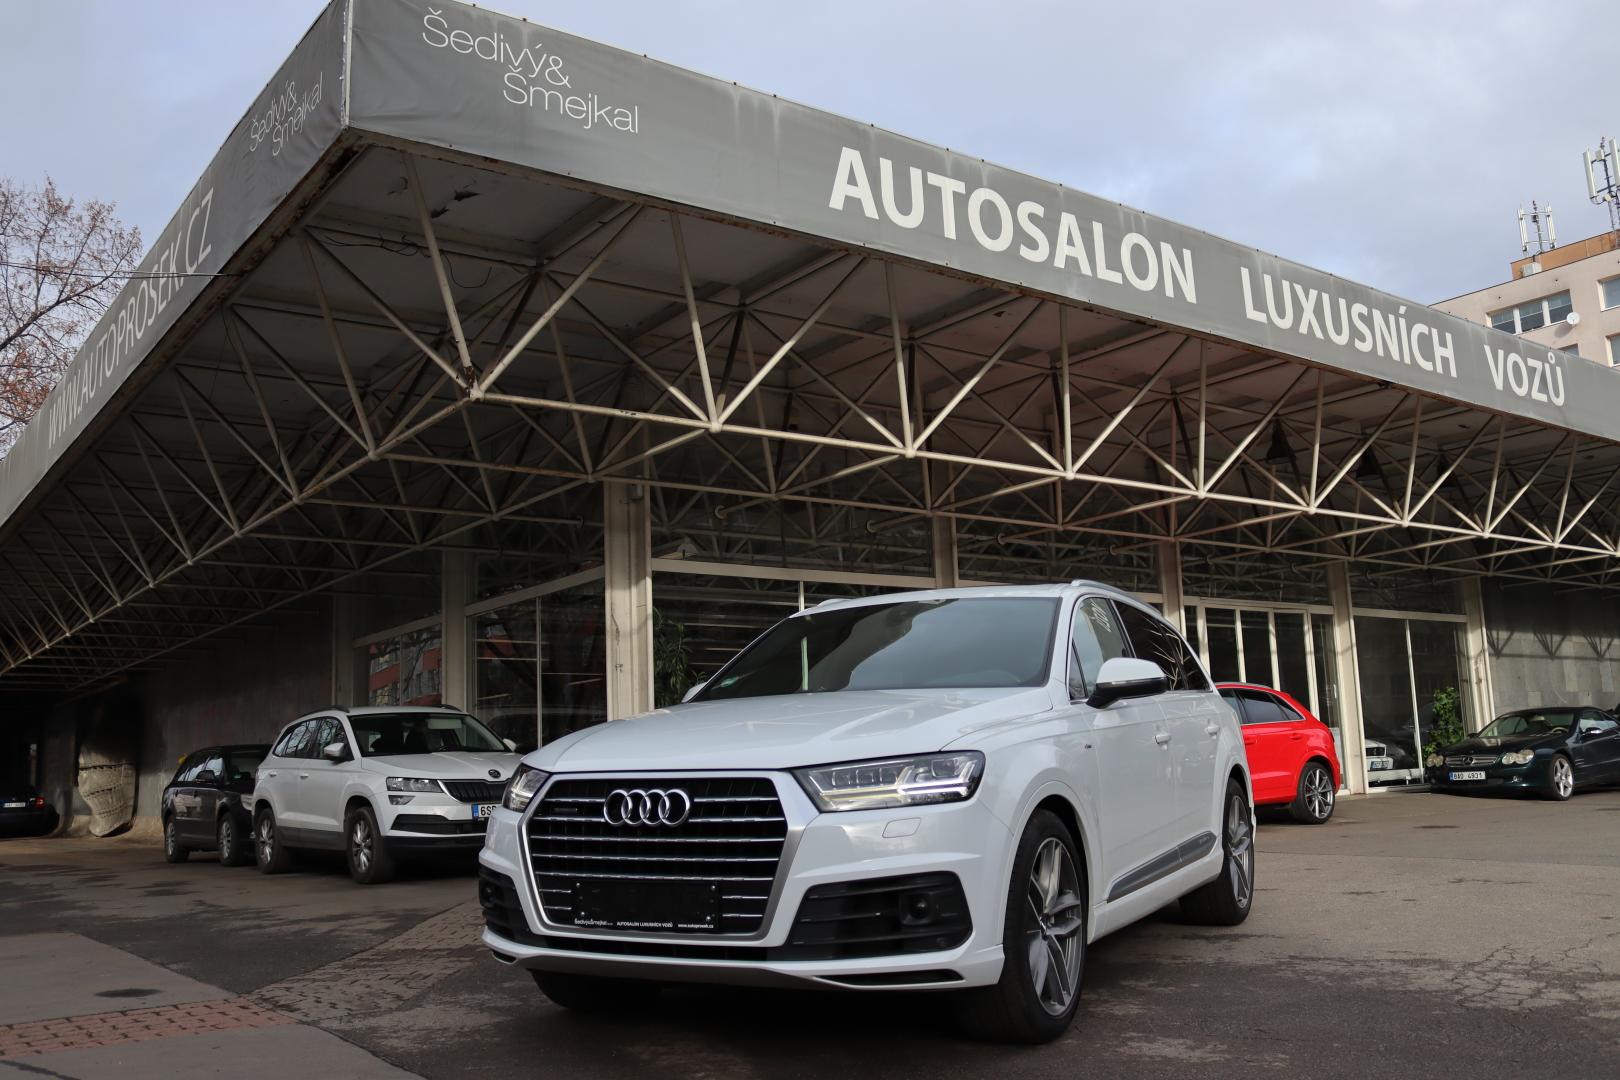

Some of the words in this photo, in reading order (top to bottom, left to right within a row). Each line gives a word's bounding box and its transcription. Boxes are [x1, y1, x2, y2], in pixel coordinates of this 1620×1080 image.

[503, 64, 639, 134] Šmejkal
[48, 187, 214, 449] WWW.AUTOPROSEK.CZ
[828, 146, 1197, 304] AUTOSALON
[1240, 267, 1457, 378] LUXUSNÍCH
[1484, 345, 1566, 406] VOZŮ
